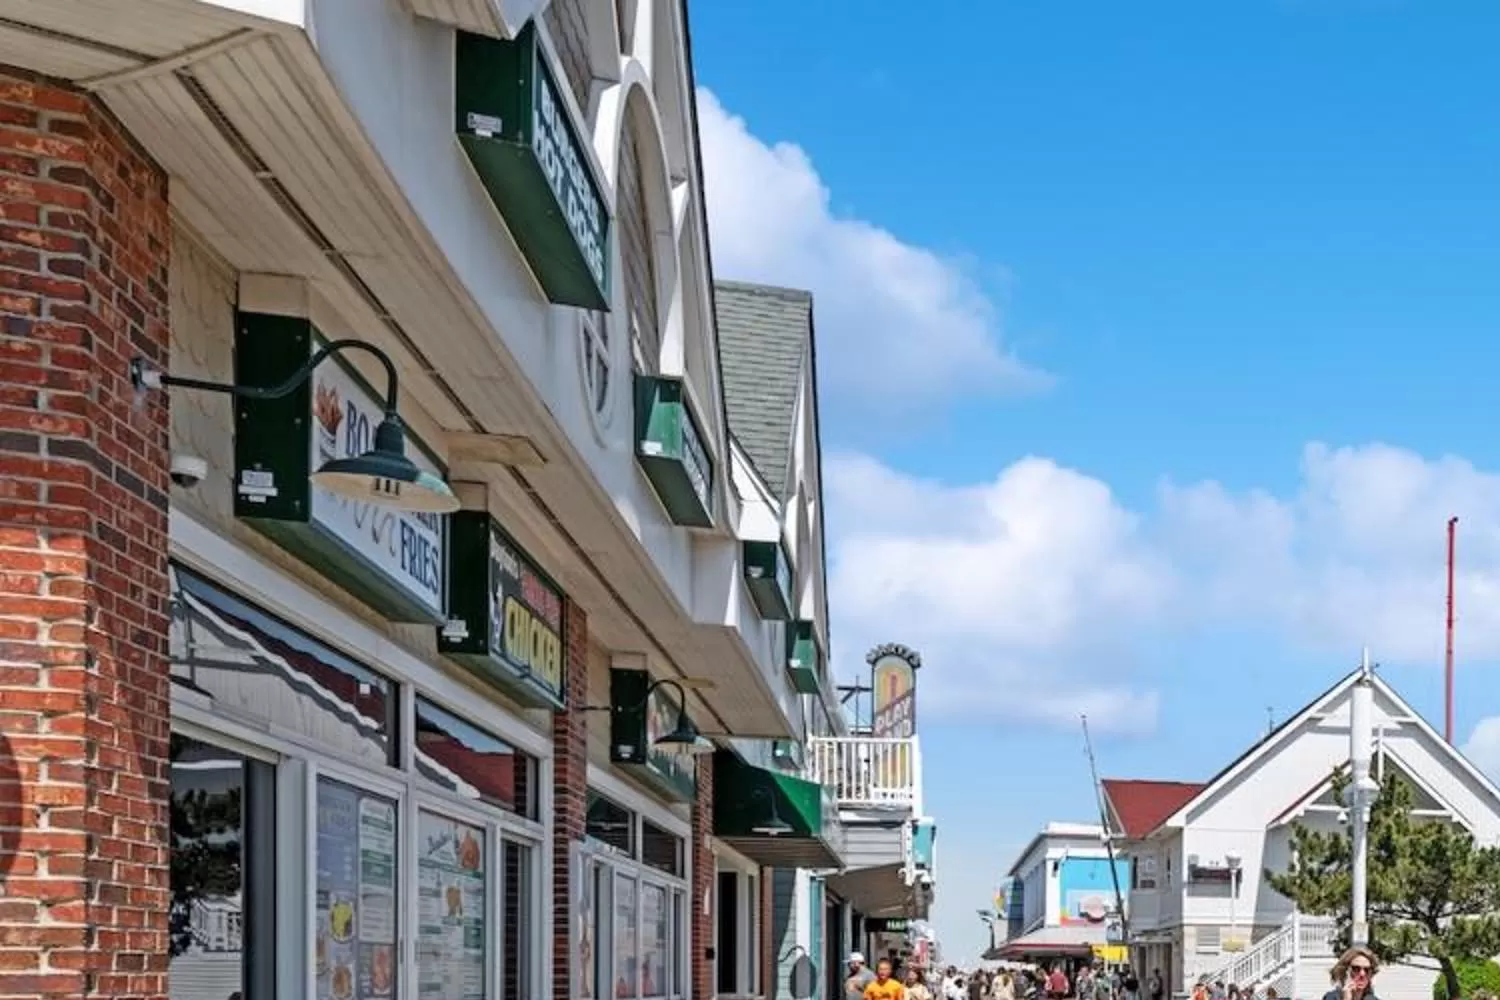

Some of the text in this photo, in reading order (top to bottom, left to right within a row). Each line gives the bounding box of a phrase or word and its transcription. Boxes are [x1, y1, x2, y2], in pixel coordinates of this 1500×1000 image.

[534, 108, 604, 283] HOT DOGS
[400, 519, 440, 596] FRIES
[505, 596, 562, 695] CHICKEN
[875, 696, 911, 736] PLAY
